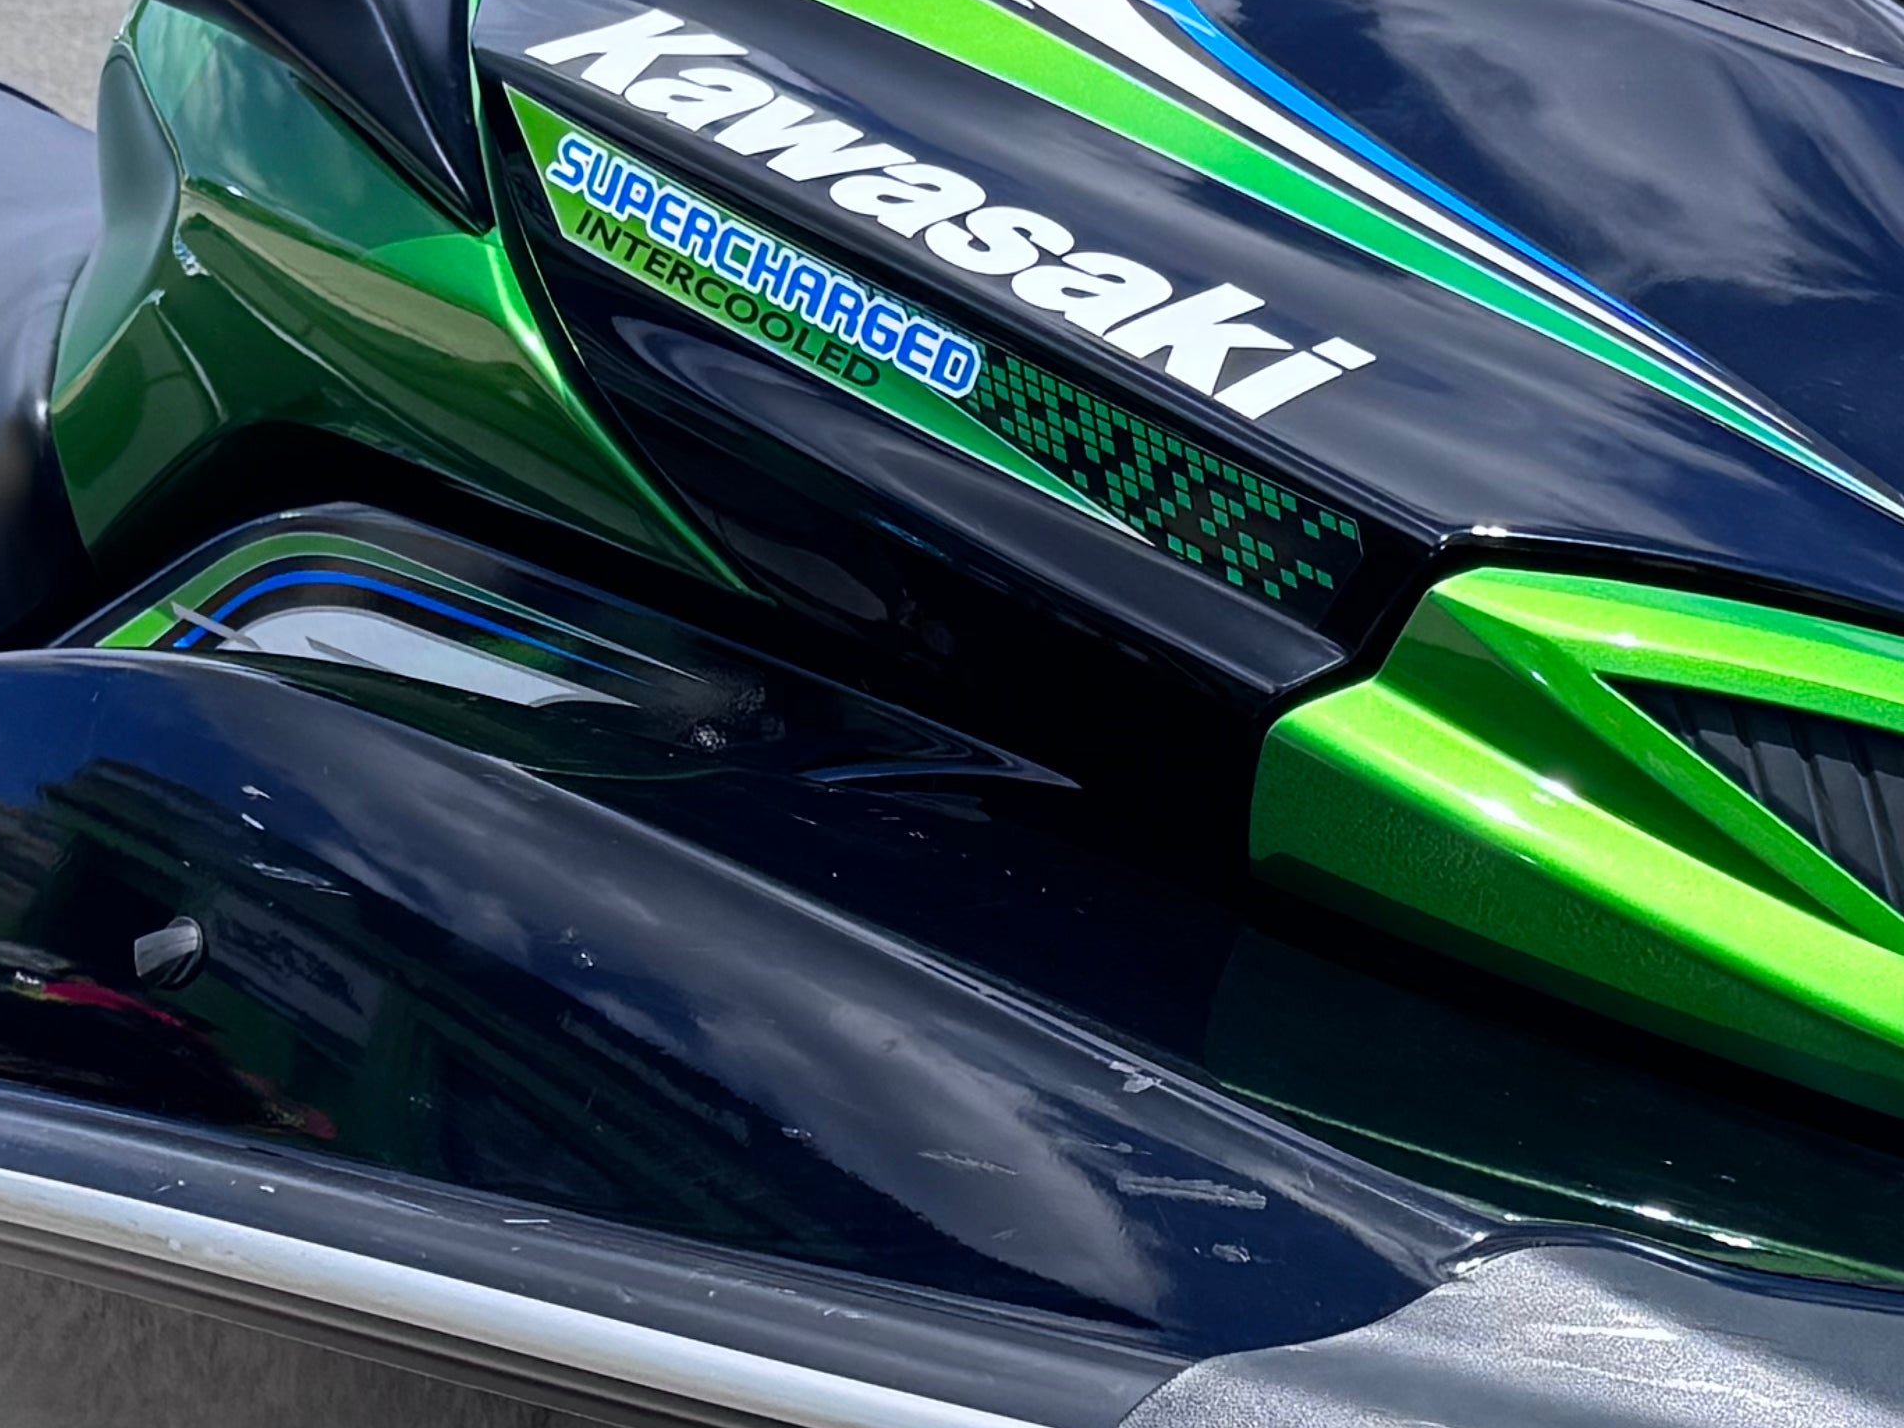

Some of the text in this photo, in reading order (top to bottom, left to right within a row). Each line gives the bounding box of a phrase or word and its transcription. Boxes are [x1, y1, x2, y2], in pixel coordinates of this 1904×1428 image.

[524, 9, 1377, 420] Kawasaki
[546, 132, 982, 400] SUPERCHARGED
[576, 209, 881, 388] INTERCOOLED
